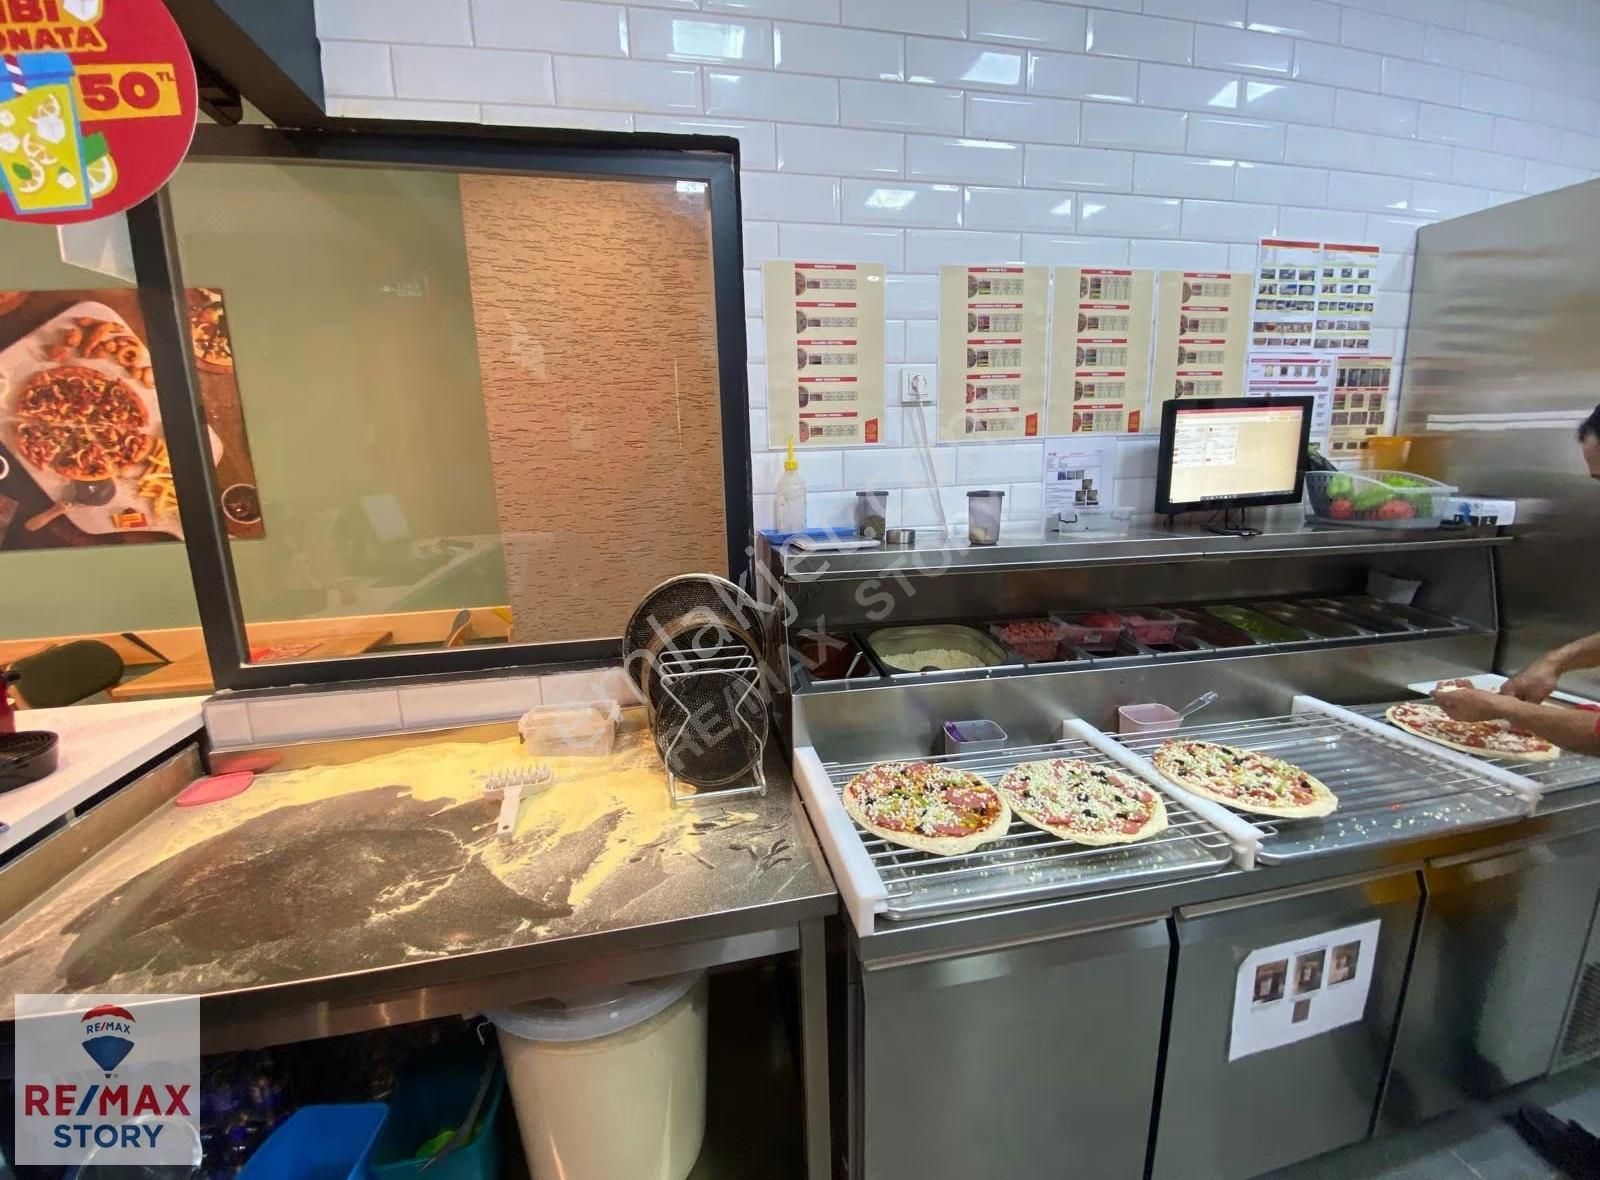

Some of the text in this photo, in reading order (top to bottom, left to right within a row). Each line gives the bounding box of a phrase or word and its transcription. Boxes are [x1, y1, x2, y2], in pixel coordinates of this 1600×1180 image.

[0, 26, 103, 50] NATA
[78, 71, 175, 111] 50 TL
